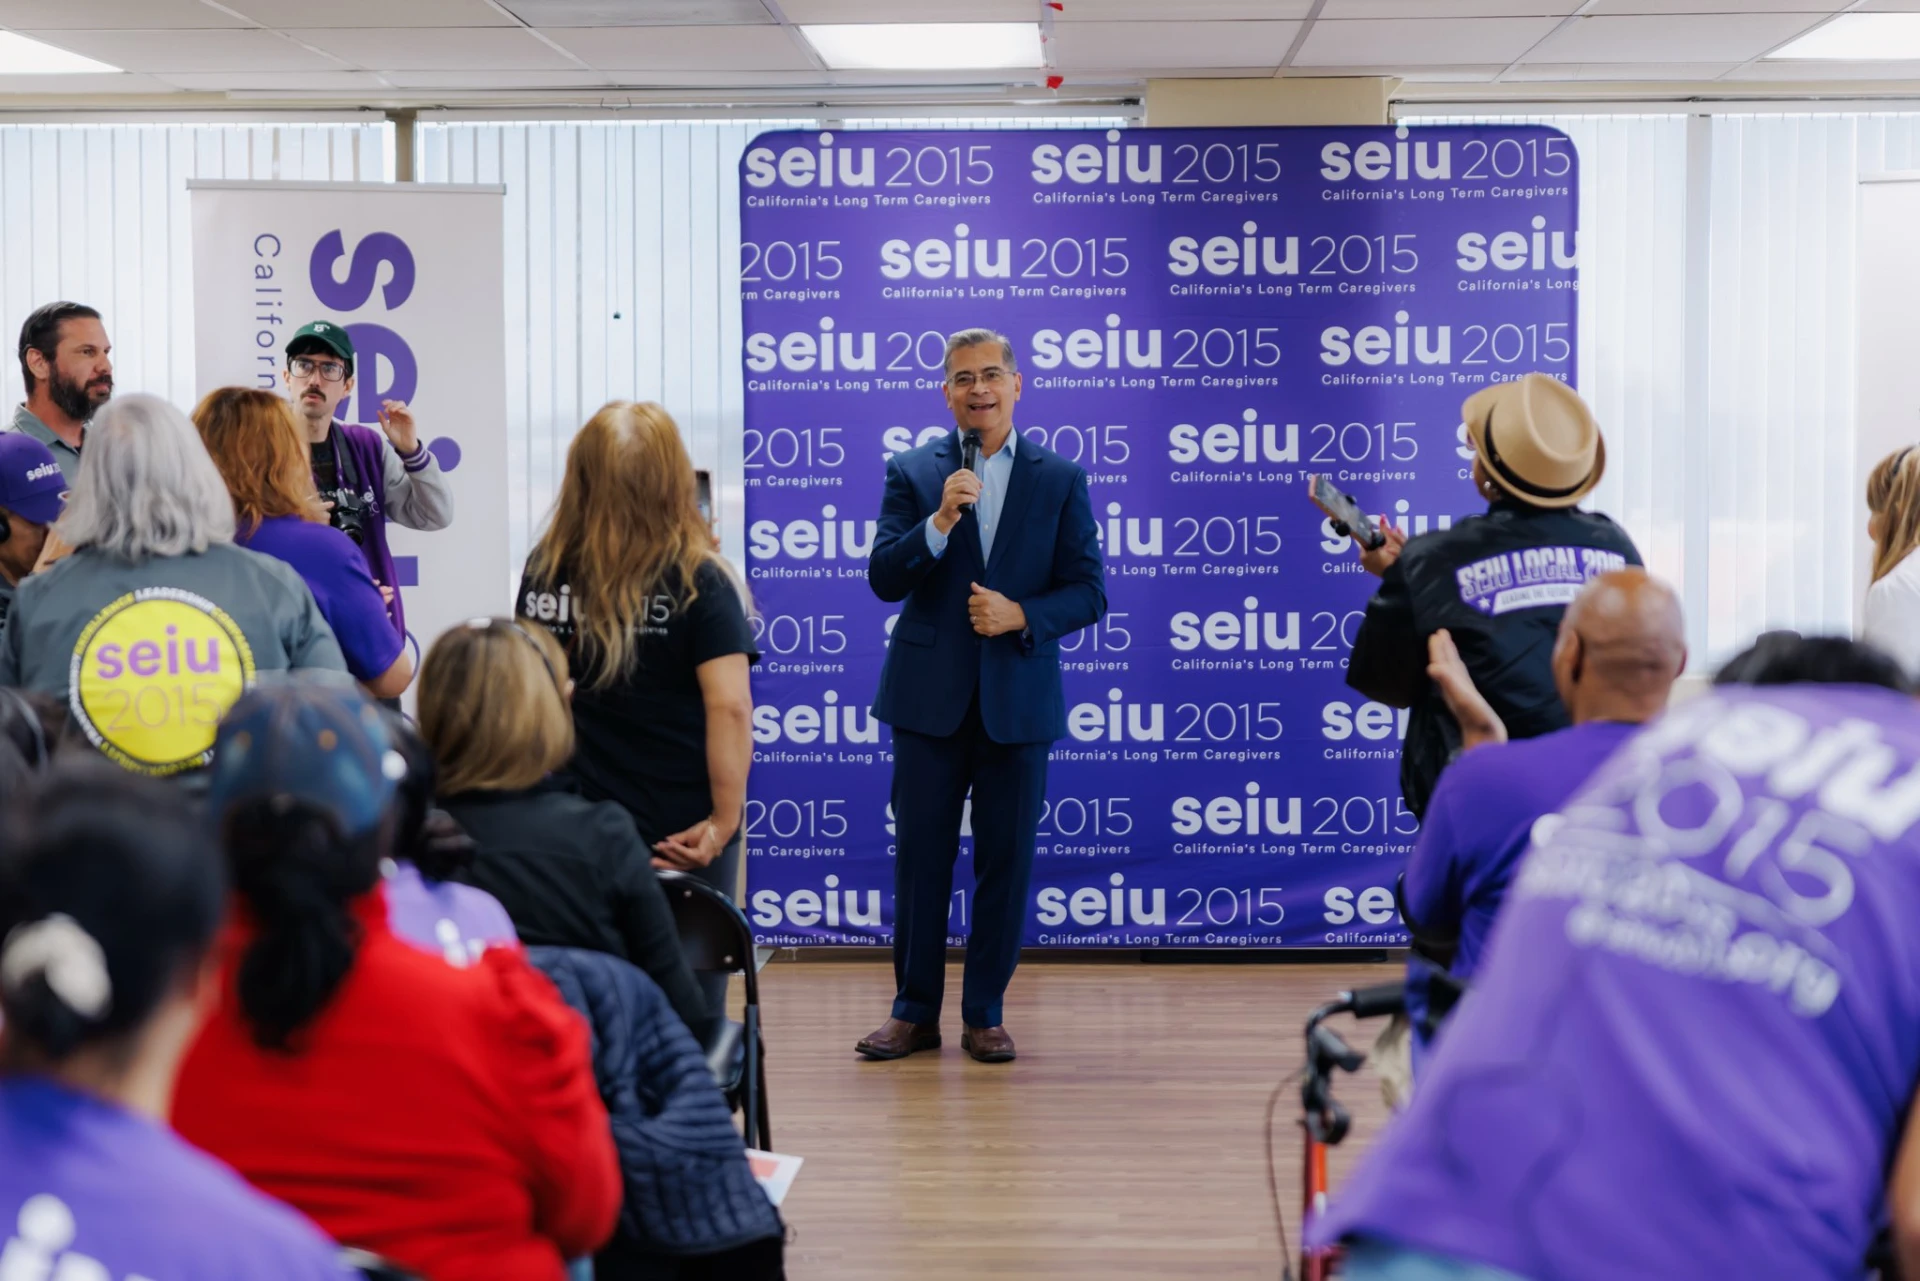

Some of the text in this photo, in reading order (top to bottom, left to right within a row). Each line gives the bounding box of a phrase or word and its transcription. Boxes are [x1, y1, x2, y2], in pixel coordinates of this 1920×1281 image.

[745, 131, 994, 188] seiu 2015
[1030, 129, 1281, 185] seiu 2015
[1318, 126, 1571, 182] seiu 2015
[746, 192, 991, 209] California's Long Term Caregivers
[1032, 190, 1279, 205] California's Long Term Caregivers
[1321, 185, 1569, 202] California's Long Term Caregivers
[880, 222, 1130, 280] seiu 2015
[1167, 220, 1419, 277] seiu 2015
[1454, 213, 1579, 273] seiu
[741, 240, 845, 283] 2015
[882, 284, 1127, 300] California's Long Term Caregivers
[1169, 281, 1417, 297] California's Long Term Caregivers
[1457, 276, 1579, 292] California's Long
[740, 287, 841, 302] rm Caregivers
[746, 316, 948, 373] seiu 20
[1031, 313, 1281, 370] seiu 2015
[1319, 309, 1571, 366] seiu 2015
[747, 378, 830, 392] California's
[835, 379, 870, 393] Long
[874, 378, 910, 390] Term
[1032, 374, 1279, 390] California's Long Term Caregivers
[1321, 372, 1405, 385] California's
[1409, 372, 1445, 387] Long
[1449, 371, 1485, 384] Term
[1168, 407, 1300, 464] seiu
[1309, 421, 1419, 463] 2015
[744, 427, 847, 471] 2015
[743, 474, 843, 490] rm Caregivers
[1086, 472, 1130, 487] givers
[1170, 470, 1253, 483] California's
[1258, 470, 1293, 484] Long
[1338, 468, 1417, 484] Caregivers
[747, 503, 874, 562] seiu
[1173, 516, 1282, 557] 2015
[750, 566, 869, 583] California's Long
[1122, 563, 1157, 578] Long
[1161, 563, 1197, 575] Term
[1201, 562, 1279, 577] Caregivers
[1457, 554, 1514, 601] SEIU
[1512, 547, 1584, 584] LOCAL
[1169, 595, 1367, 652] seiu 20
[96, 624, 220, 679] seiu
[768, 661, 845, 676] Caregivers
[1059, 659, 1131, 674] aregivers
[1171, 658, 1254, 670] California's
[1259, 658, 1294, 672] Long
[1299, 657, 1334, 670] Term
[104, 683, 221, 732] 2015
[1067, 687, 1283, 742] eiu 2015
[752, 690, 881, 745] seiu
[750, 749, 834, 763] California's
[839, 751, 873, 765] Long
[1048, 747, 1281, 763] alifornia's Long Term Caregivers
[1171, 781, 1420, 836] seiu 2015
[745, 799, 848, 839] 2015
[745, 845, 846, 859] rm Caregivers
[1053, 843, 1131, 857] Caregivers
[1173, 842, 1256, 854] California's
[1261, 843, 1296, 857] Long
[1300, 842, 1336, 854] Term
[751, 874, 882, 928] seiu
[1036, 872, 1285, 927] seiu 2015
[752, 933, 838, 946] California's
[840, 933, 876, 946] Long
[1038, 932, 1282, 946] California's Long Term Caregivers
[1324, 931, 1408, 944] California's
